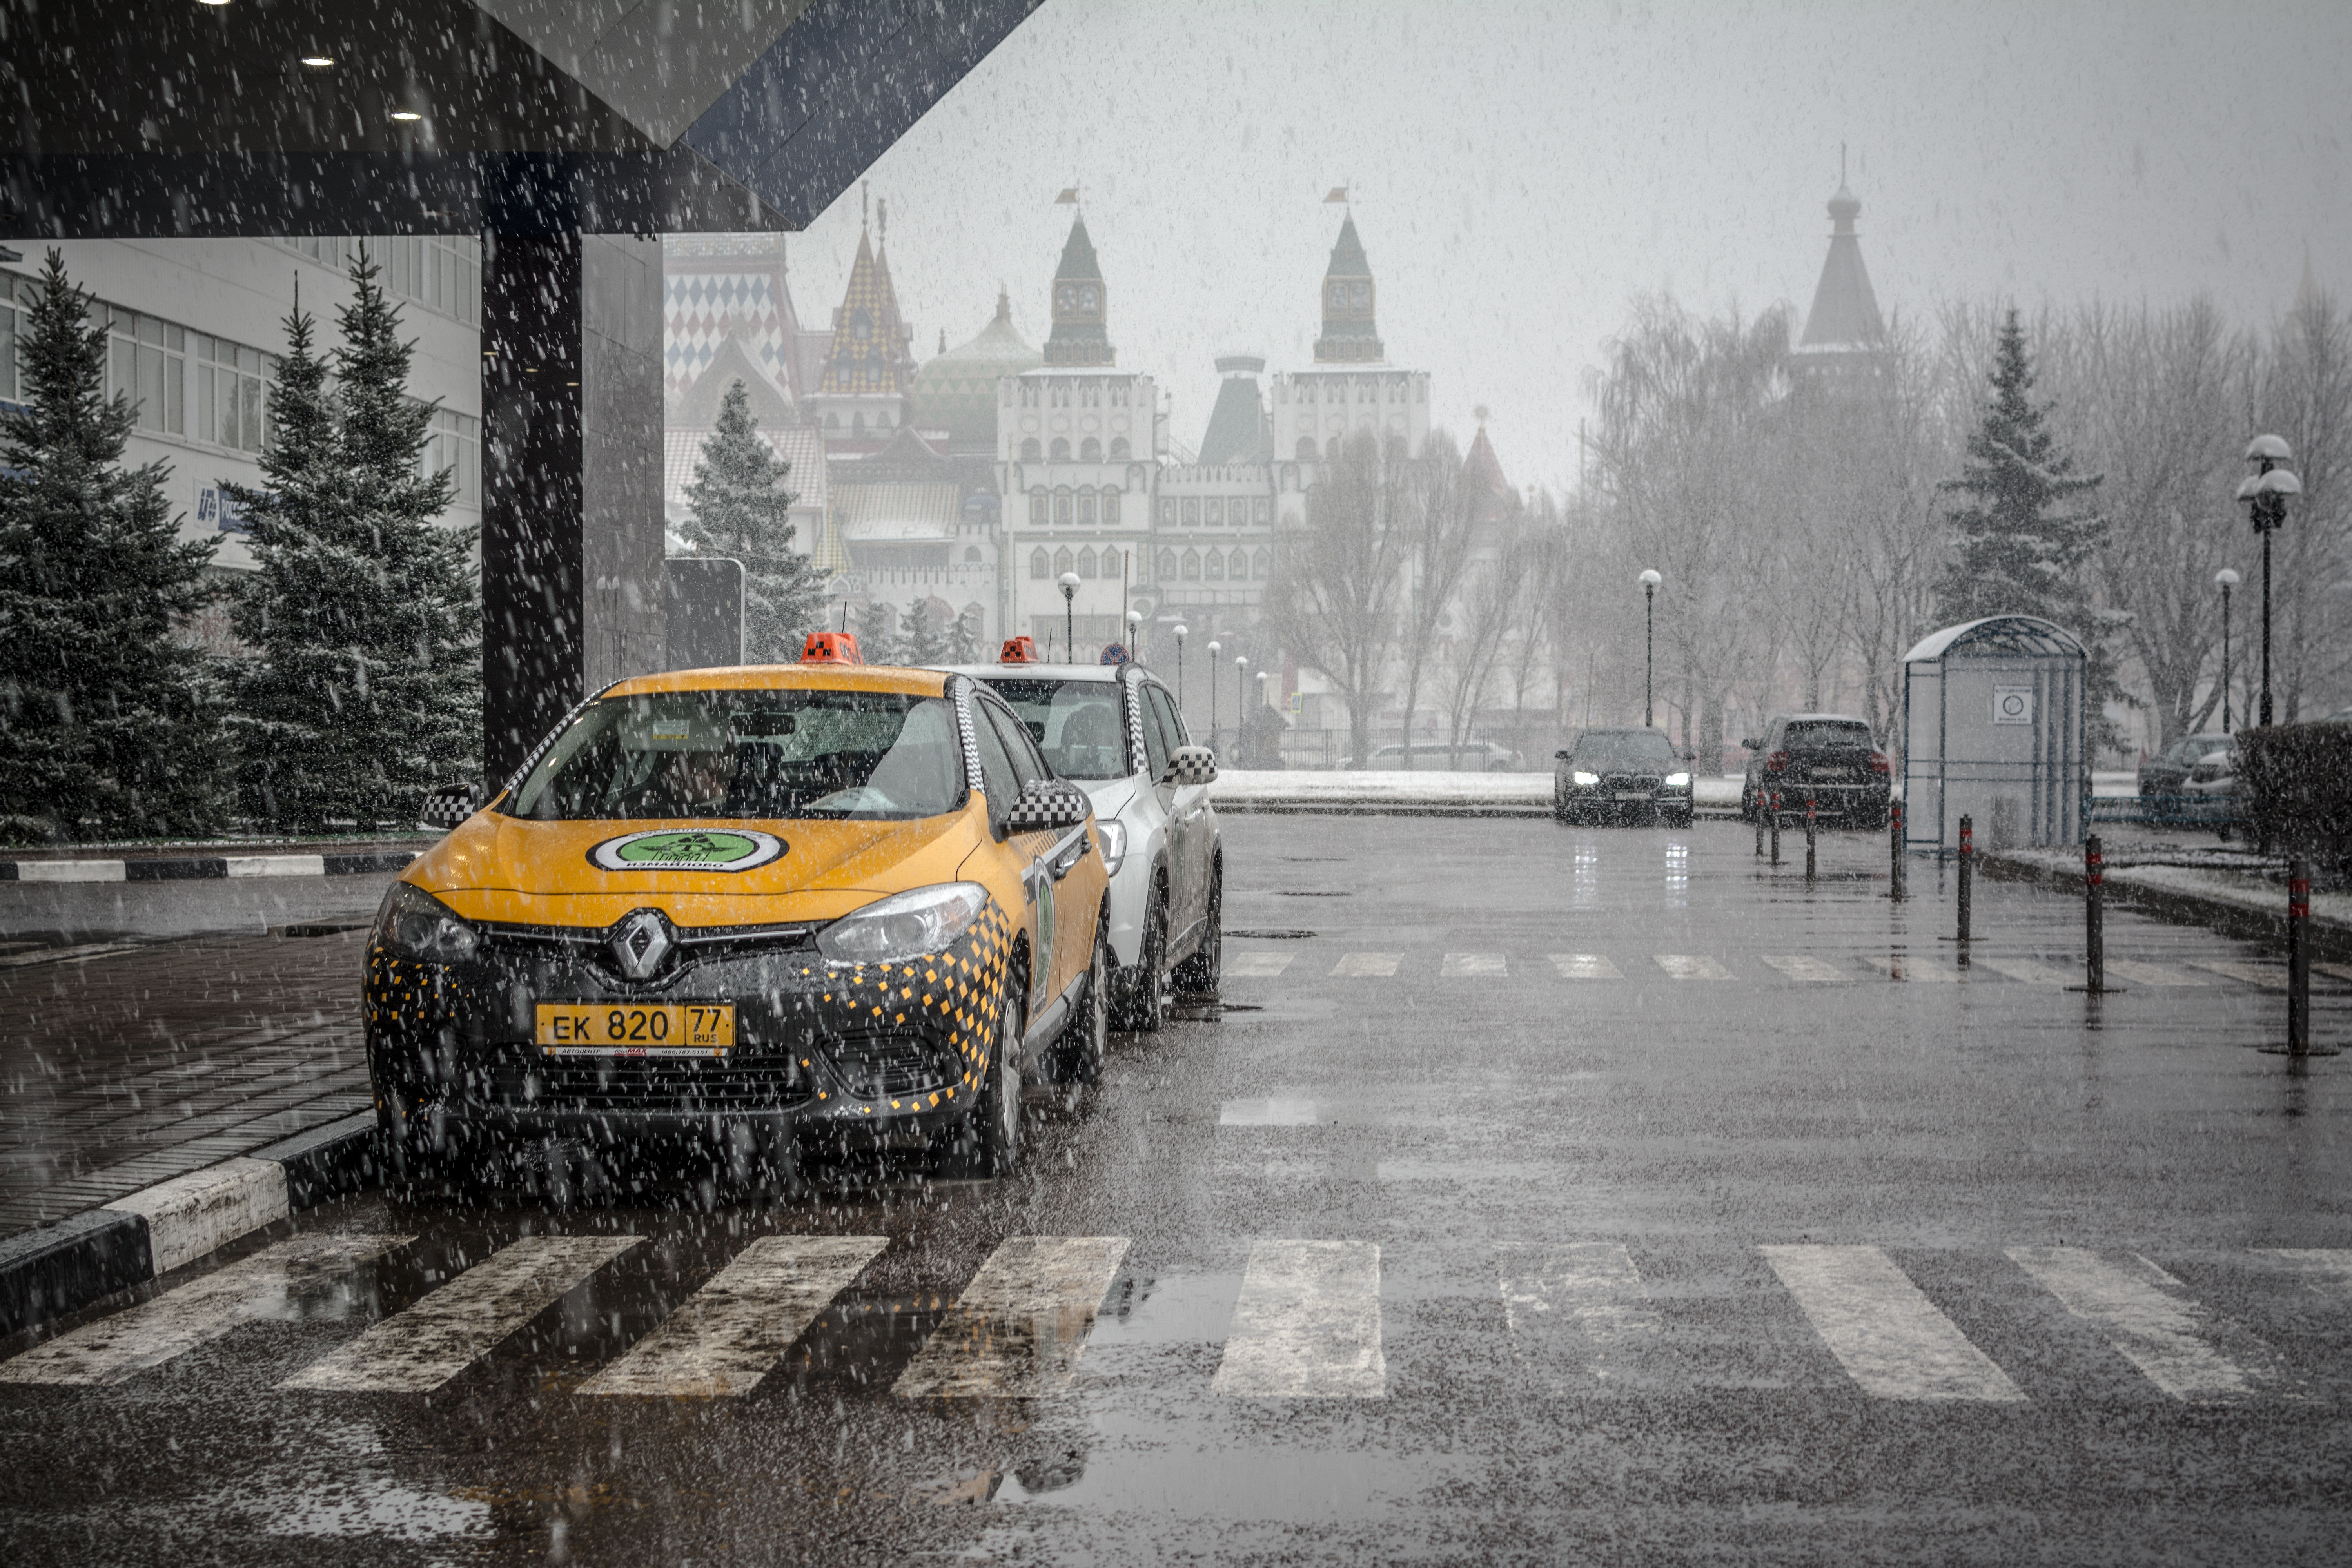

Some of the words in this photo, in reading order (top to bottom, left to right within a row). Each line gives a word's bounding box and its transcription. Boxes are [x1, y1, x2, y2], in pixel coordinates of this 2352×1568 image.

[608, 1010, 668, 1040] 820
[690, 1009, 721, 1032] 77
[694, 1034, 717, 1043] RUS
